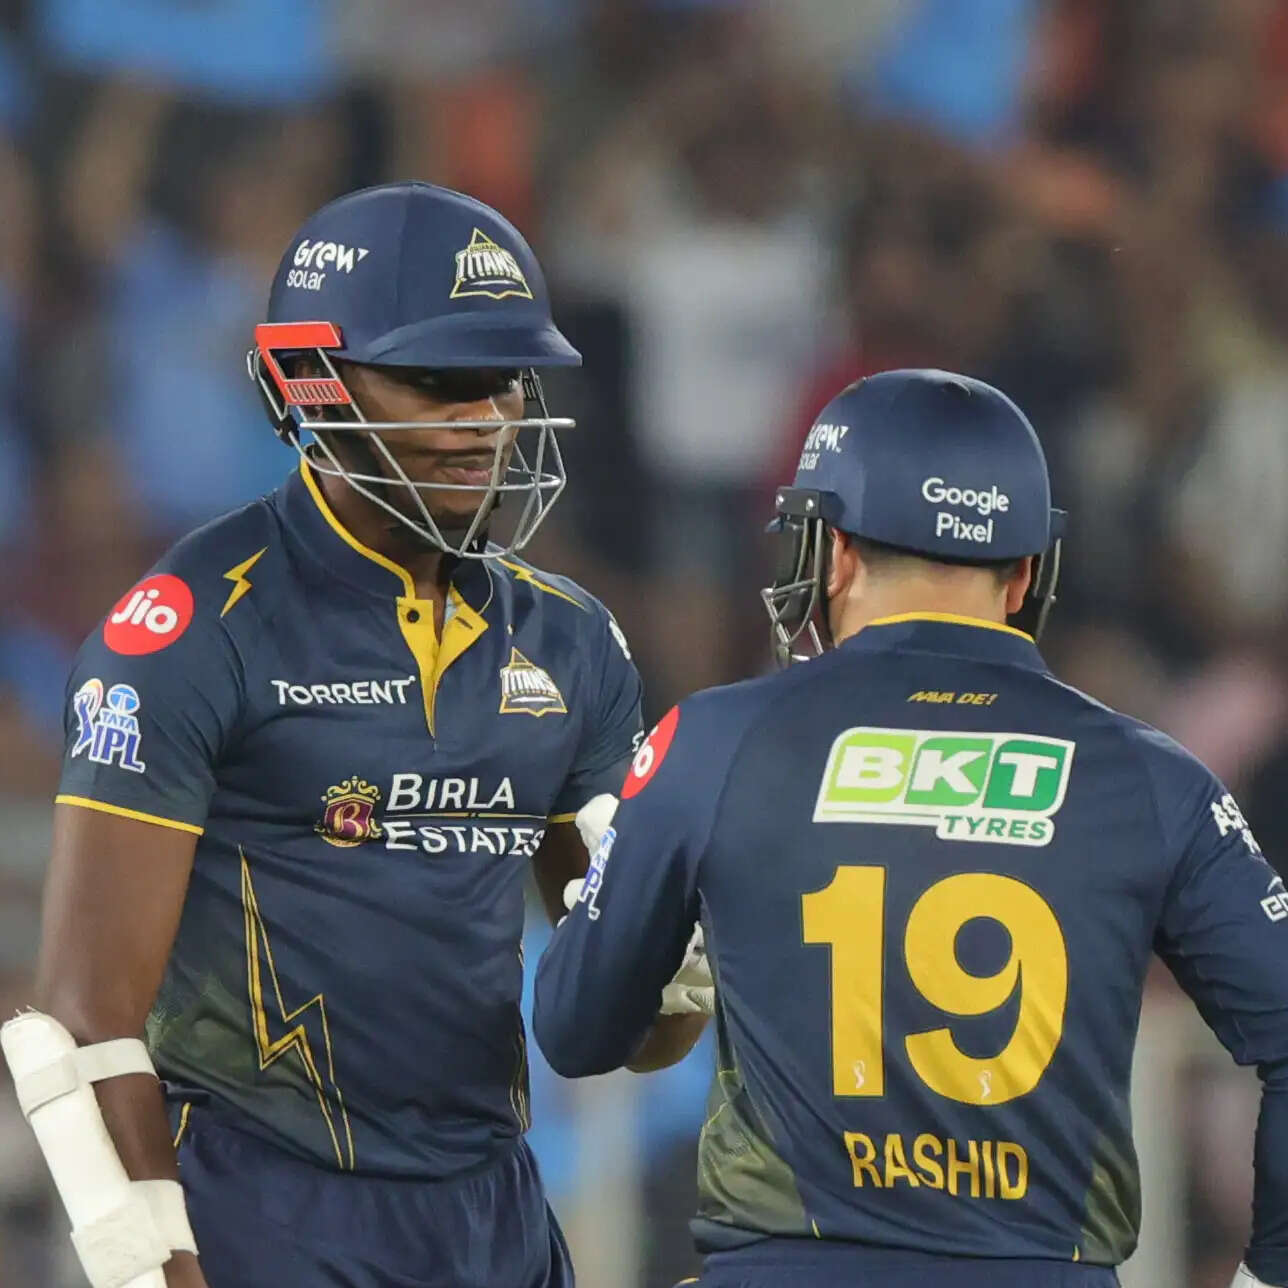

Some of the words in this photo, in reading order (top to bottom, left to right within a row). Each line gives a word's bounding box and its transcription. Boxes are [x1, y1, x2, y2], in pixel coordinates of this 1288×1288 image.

[286, 268, 326, 291] solar
[456, 249, 525, 281] TITANS
[922, 477, 1010, 516] Google
[935, 511, 994, 544] Pixel
[270, 677, 412, 705] TORRENT
[500, 666, 561, 698] TITANS
[101, 709, 137, 732] TATA
[90, 723, 145, 773] IPL
[834, 744, 1059, 799] BKT
[385, 773, 515, 812] BIRLA
[381, 821, 545, 857] ESTATES
[943, 814, 1048, 840] TYRES
[801, 864, 1068, 1106] 19
[843, 1130, 1029, 1201] RASHID
